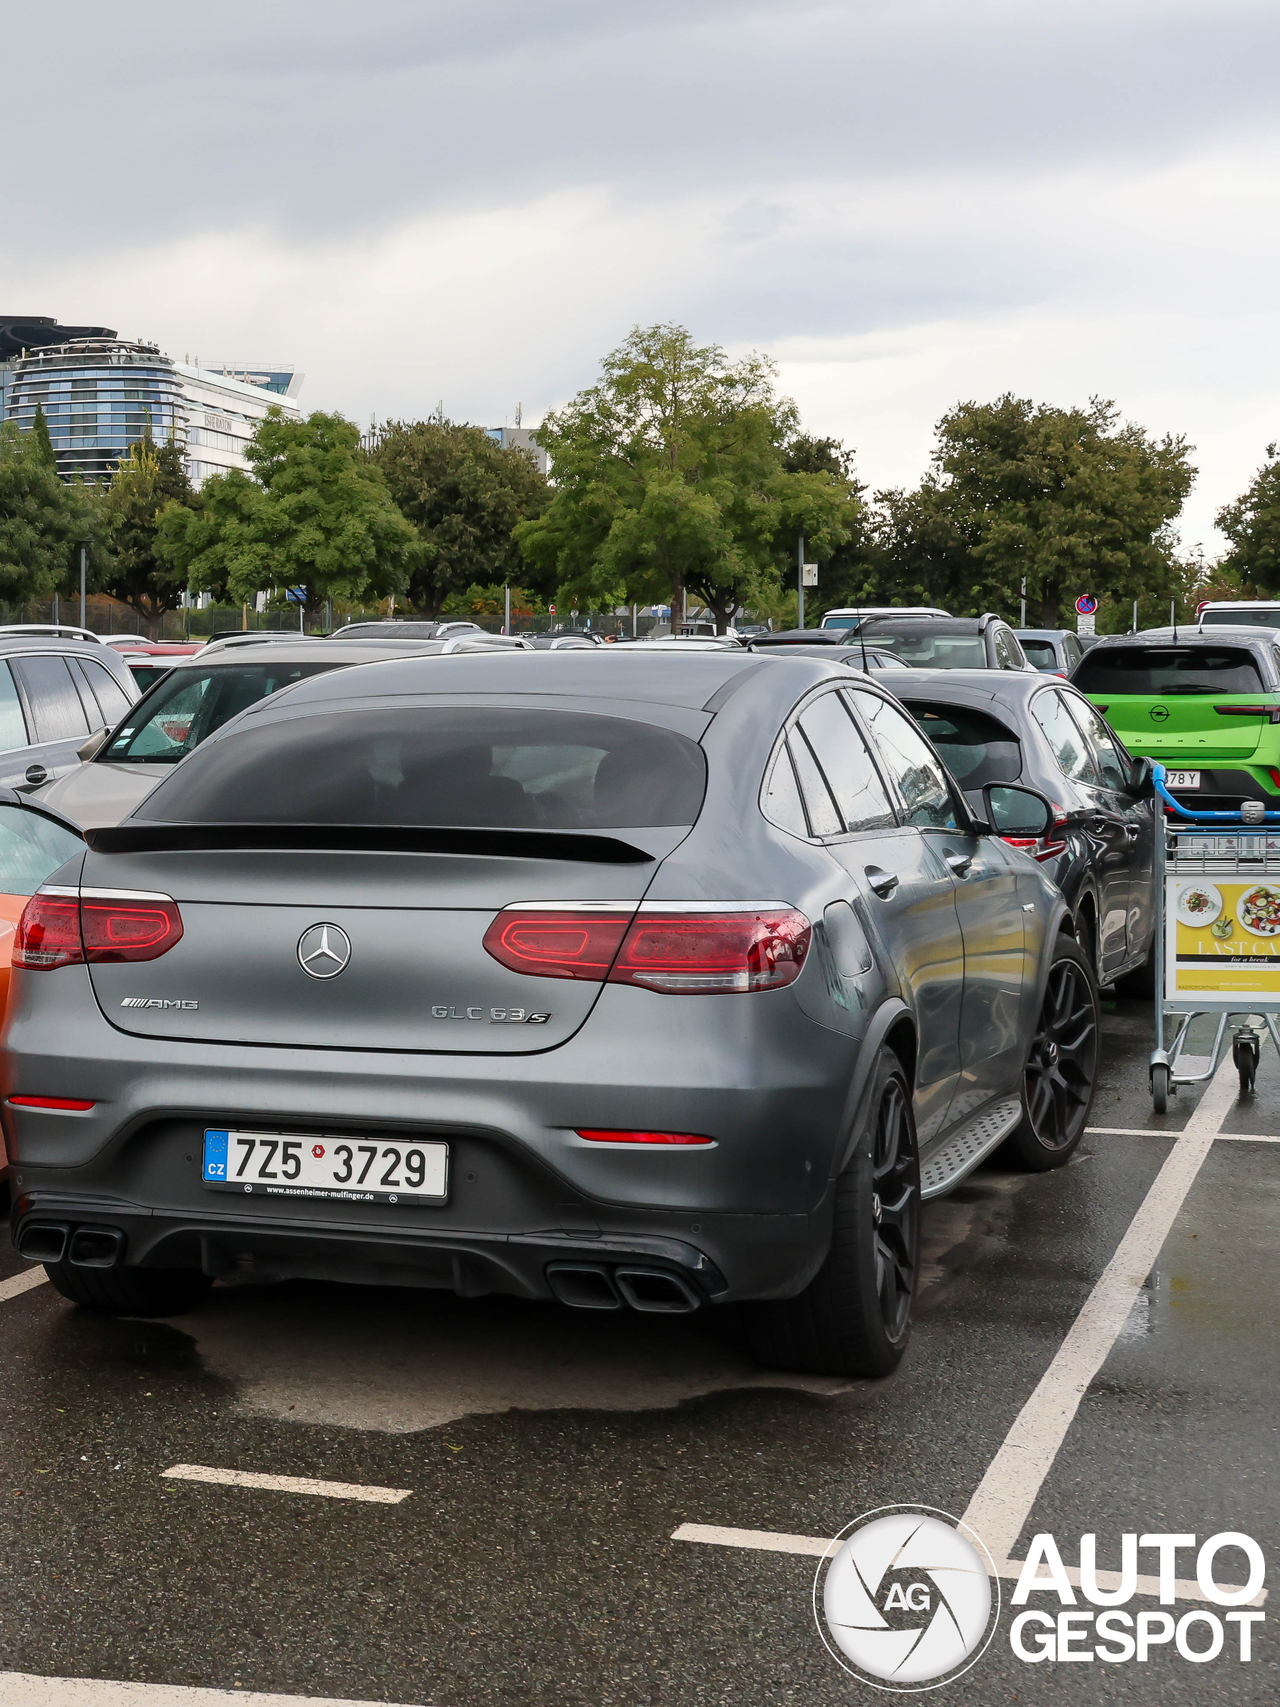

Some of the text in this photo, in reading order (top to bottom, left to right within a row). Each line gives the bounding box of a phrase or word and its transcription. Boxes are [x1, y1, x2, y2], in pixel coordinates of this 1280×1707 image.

[1197, 941, 1280, 957] LAST CA
[1248, 956, 1269, 964] break
[431, 1005, 483, 1020] GLC
[207, 1163, 225, 1176] CZ
[235, 1138, 427, 1188] 7Z5 3729
[266, 1186, 375, 1201] www.assenheimer-mulfinger.de
